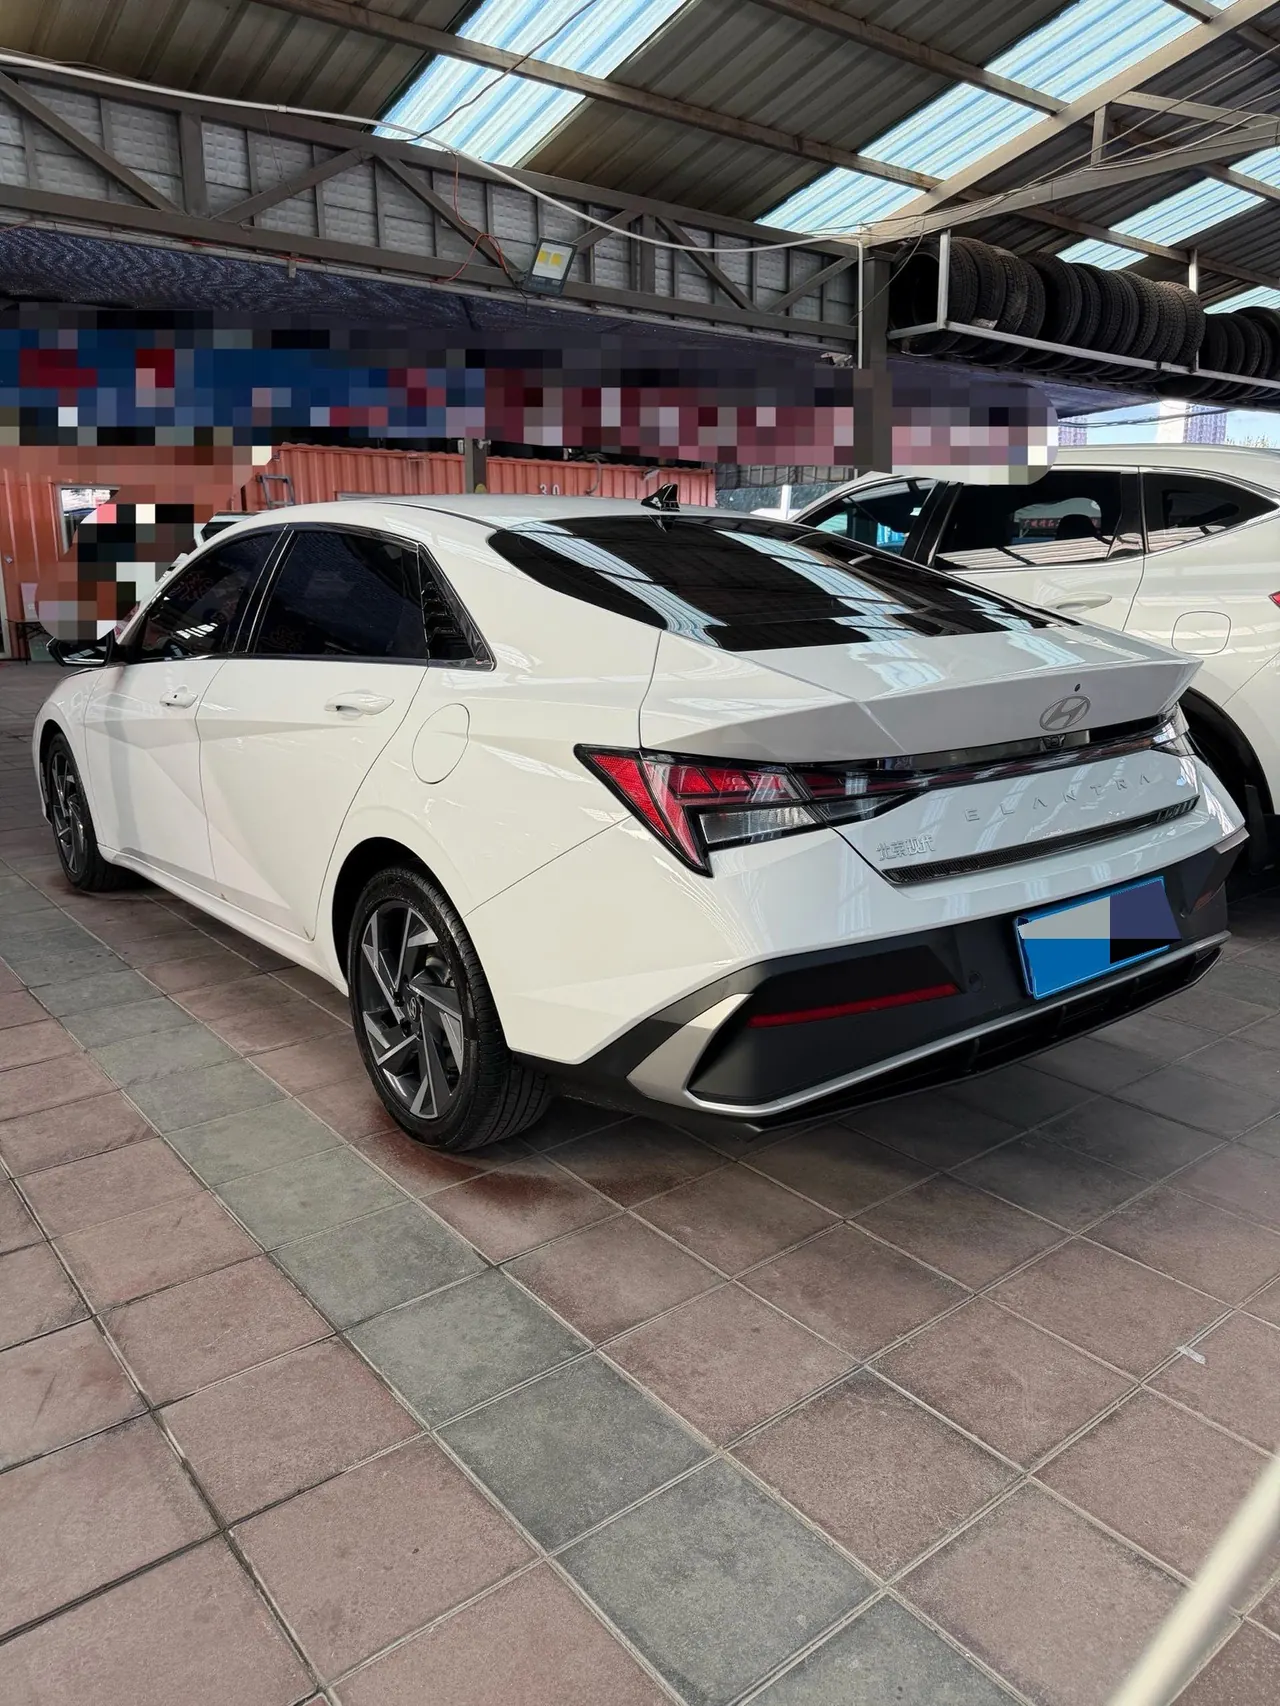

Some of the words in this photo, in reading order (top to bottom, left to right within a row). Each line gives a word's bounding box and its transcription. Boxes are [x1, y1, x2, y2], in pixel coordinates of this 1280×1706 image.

[964, 774, 1150, 821] ELANTRA
[876, 835, 936, 861] 北京现代
